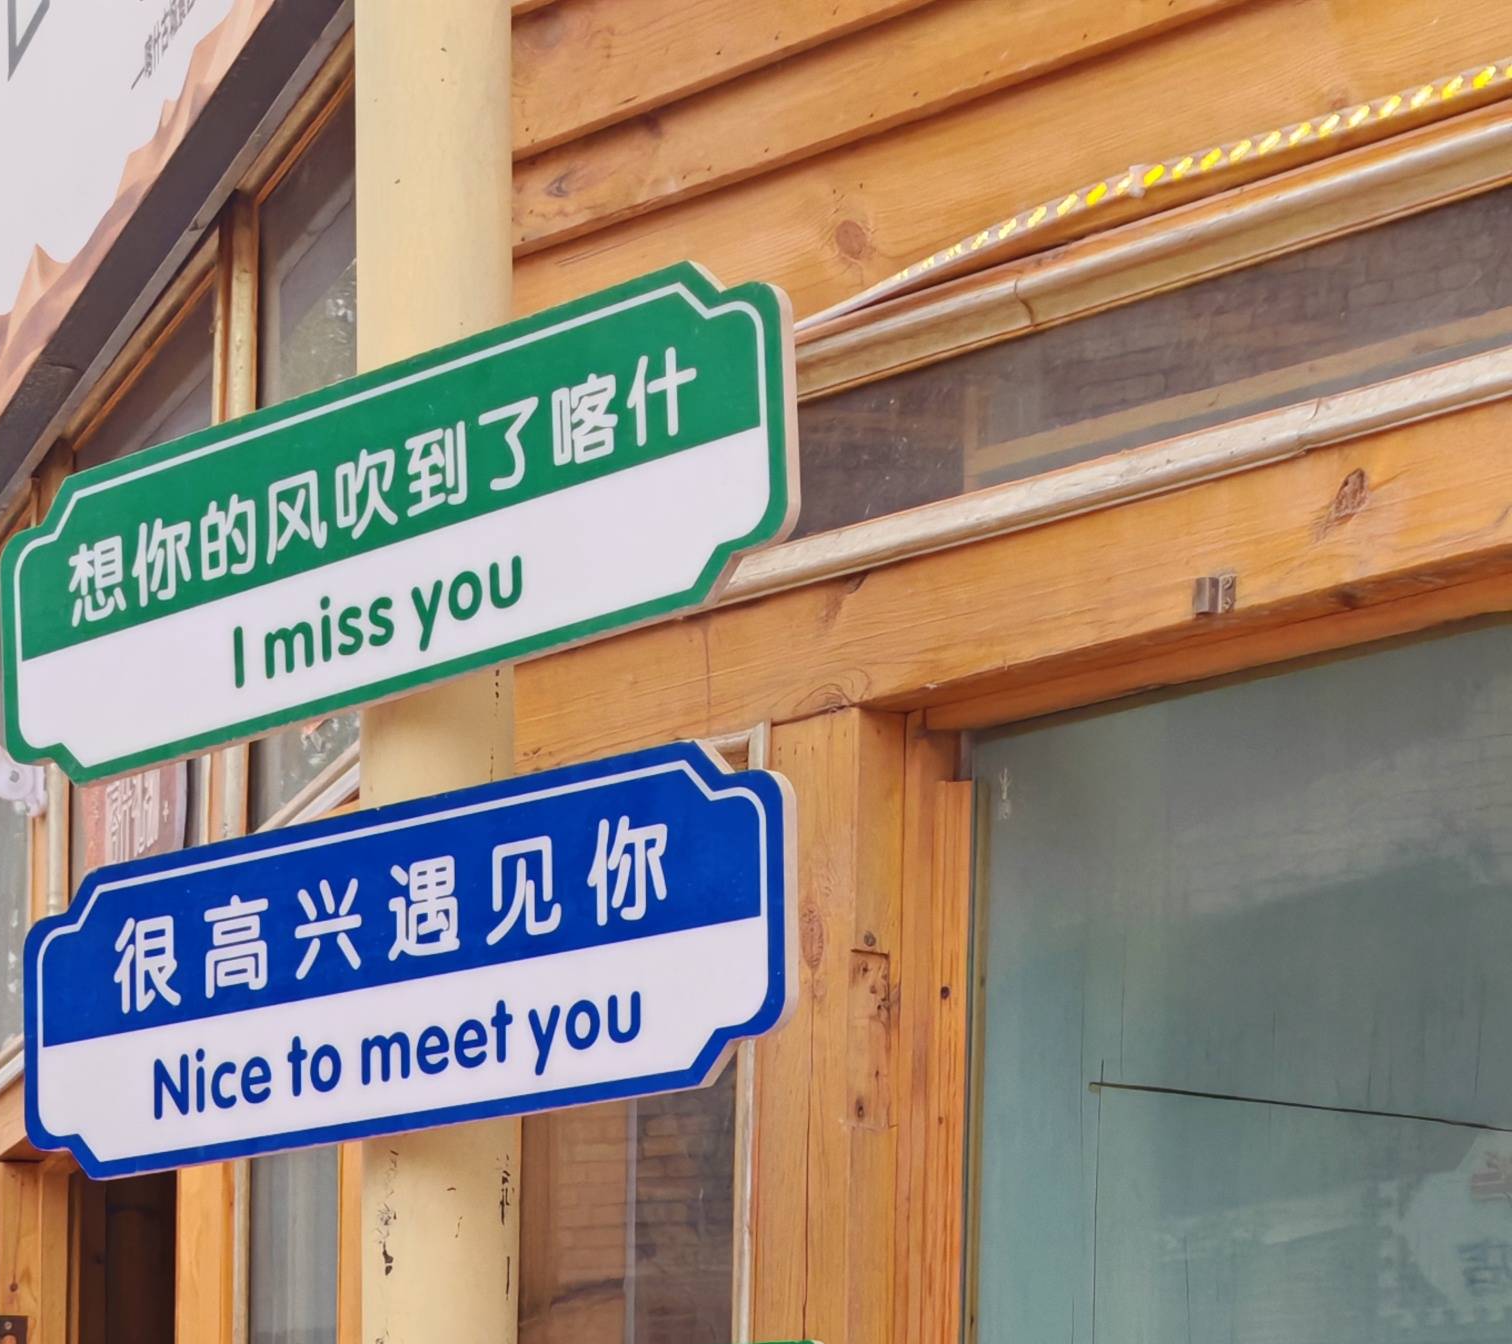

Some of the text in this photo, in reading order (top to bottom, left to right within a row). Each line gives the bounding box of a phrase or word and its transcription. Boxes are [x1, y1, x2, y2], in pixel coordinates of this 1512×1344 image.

[68, 345, 698, 628] 想你的风吹到了喀什
[232, 554, 524, 690] I miss you
[112, 814, 670, 1016] 很高兴遇见你
[151, 989, 643, 1121] Nice to meet you
